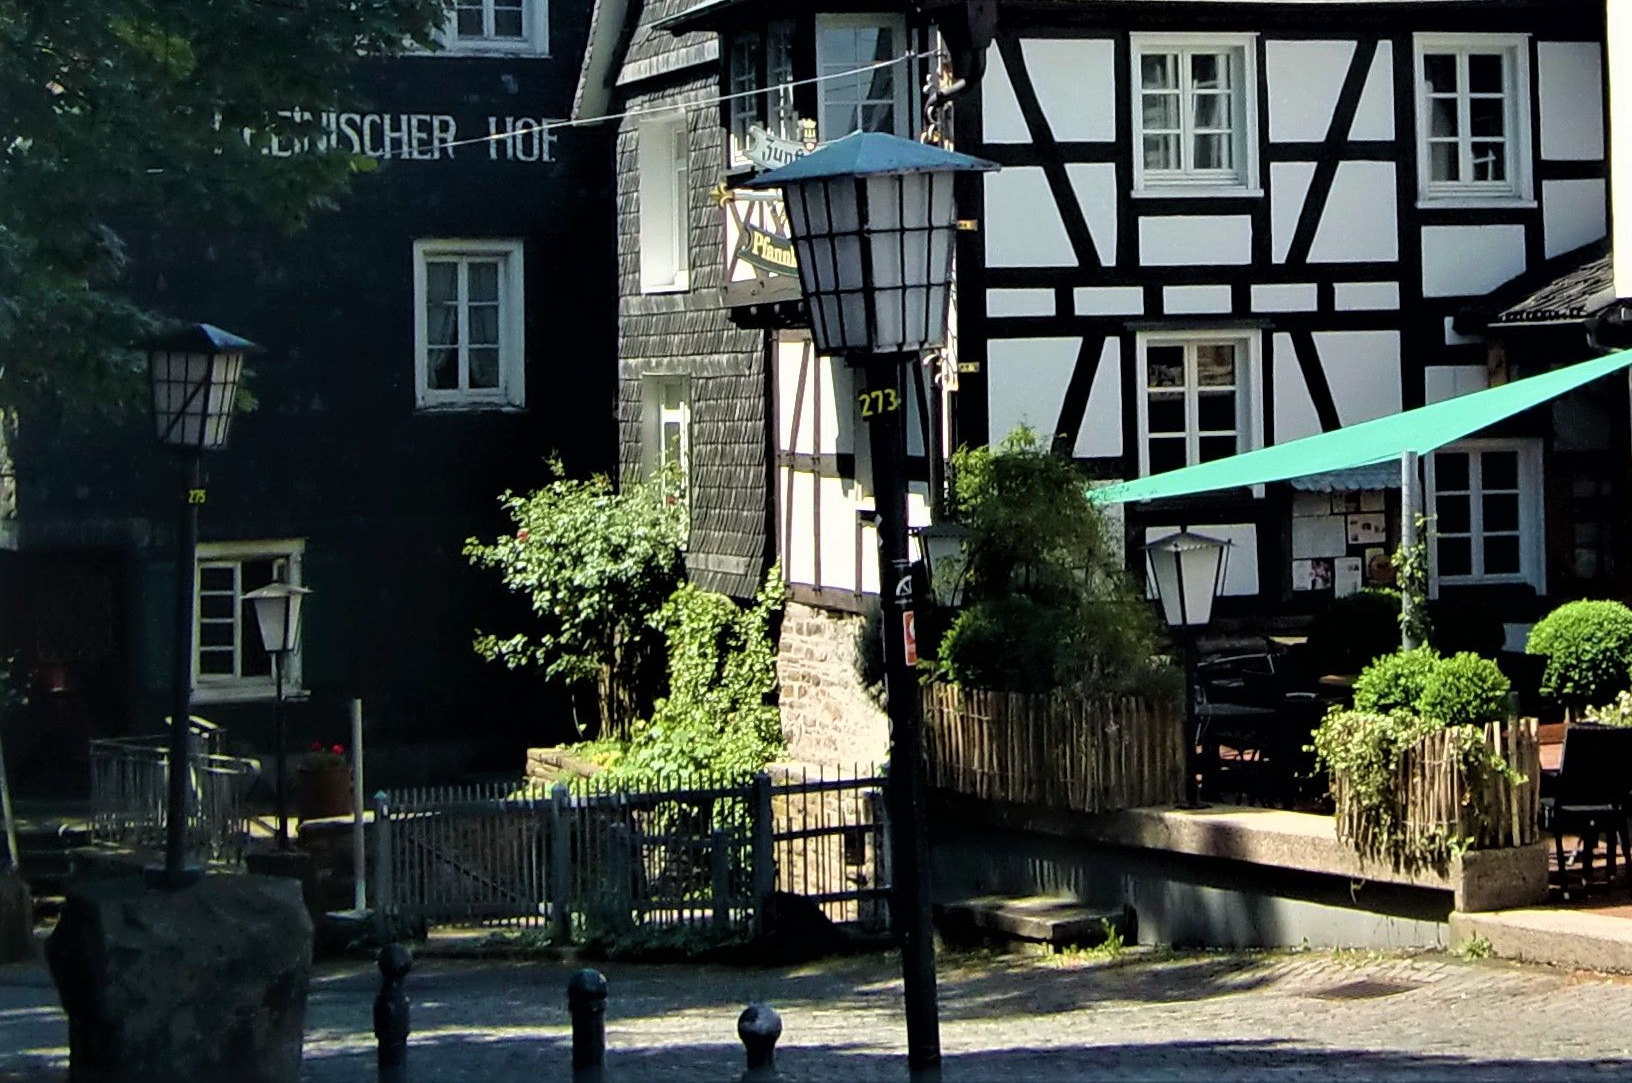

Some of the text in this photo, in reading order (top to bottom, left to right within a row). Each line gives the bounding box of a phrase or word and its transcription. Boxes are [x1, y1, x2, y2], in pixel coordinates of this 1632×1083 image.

[213, 107, 558, 162] EINISCHER HOF
[858, 389, 900, 418] 273
[188, 488, 206, 504] 275
